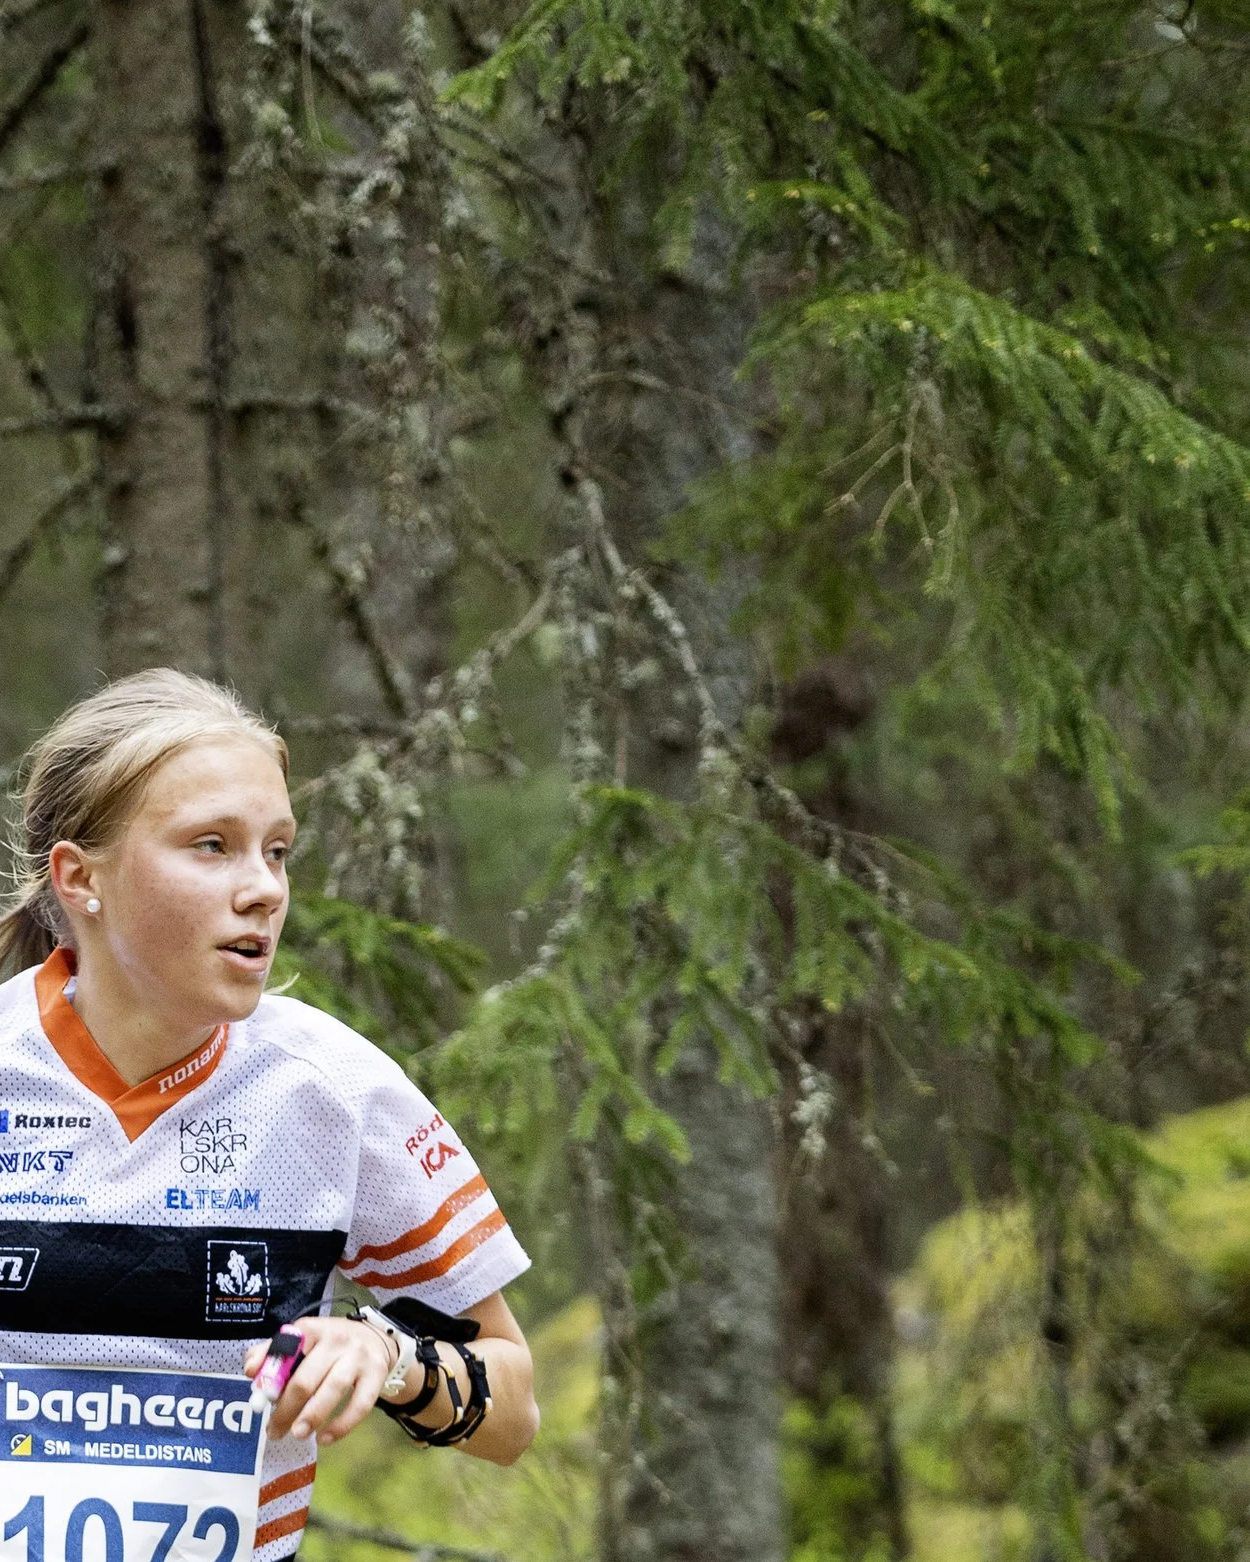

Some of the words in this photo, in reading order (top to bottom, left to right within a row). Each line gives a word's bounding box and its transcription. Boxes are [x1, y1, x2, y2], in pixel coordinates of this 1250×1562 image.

[14, 1114, 92, 1129] Roxtec
[179, 1118, 232, 1138] KAR
[180, 1133, 247, 1154] LSKR
[180, 1154, 235, 1174] ONA
[419, 1141, 461, 1180] ICA
[5, 1381, 254, 1434] bagheera
[43, 1440, 71, 1456] SM
[84, 1441, 213, 1464] MEDELDISTANS
